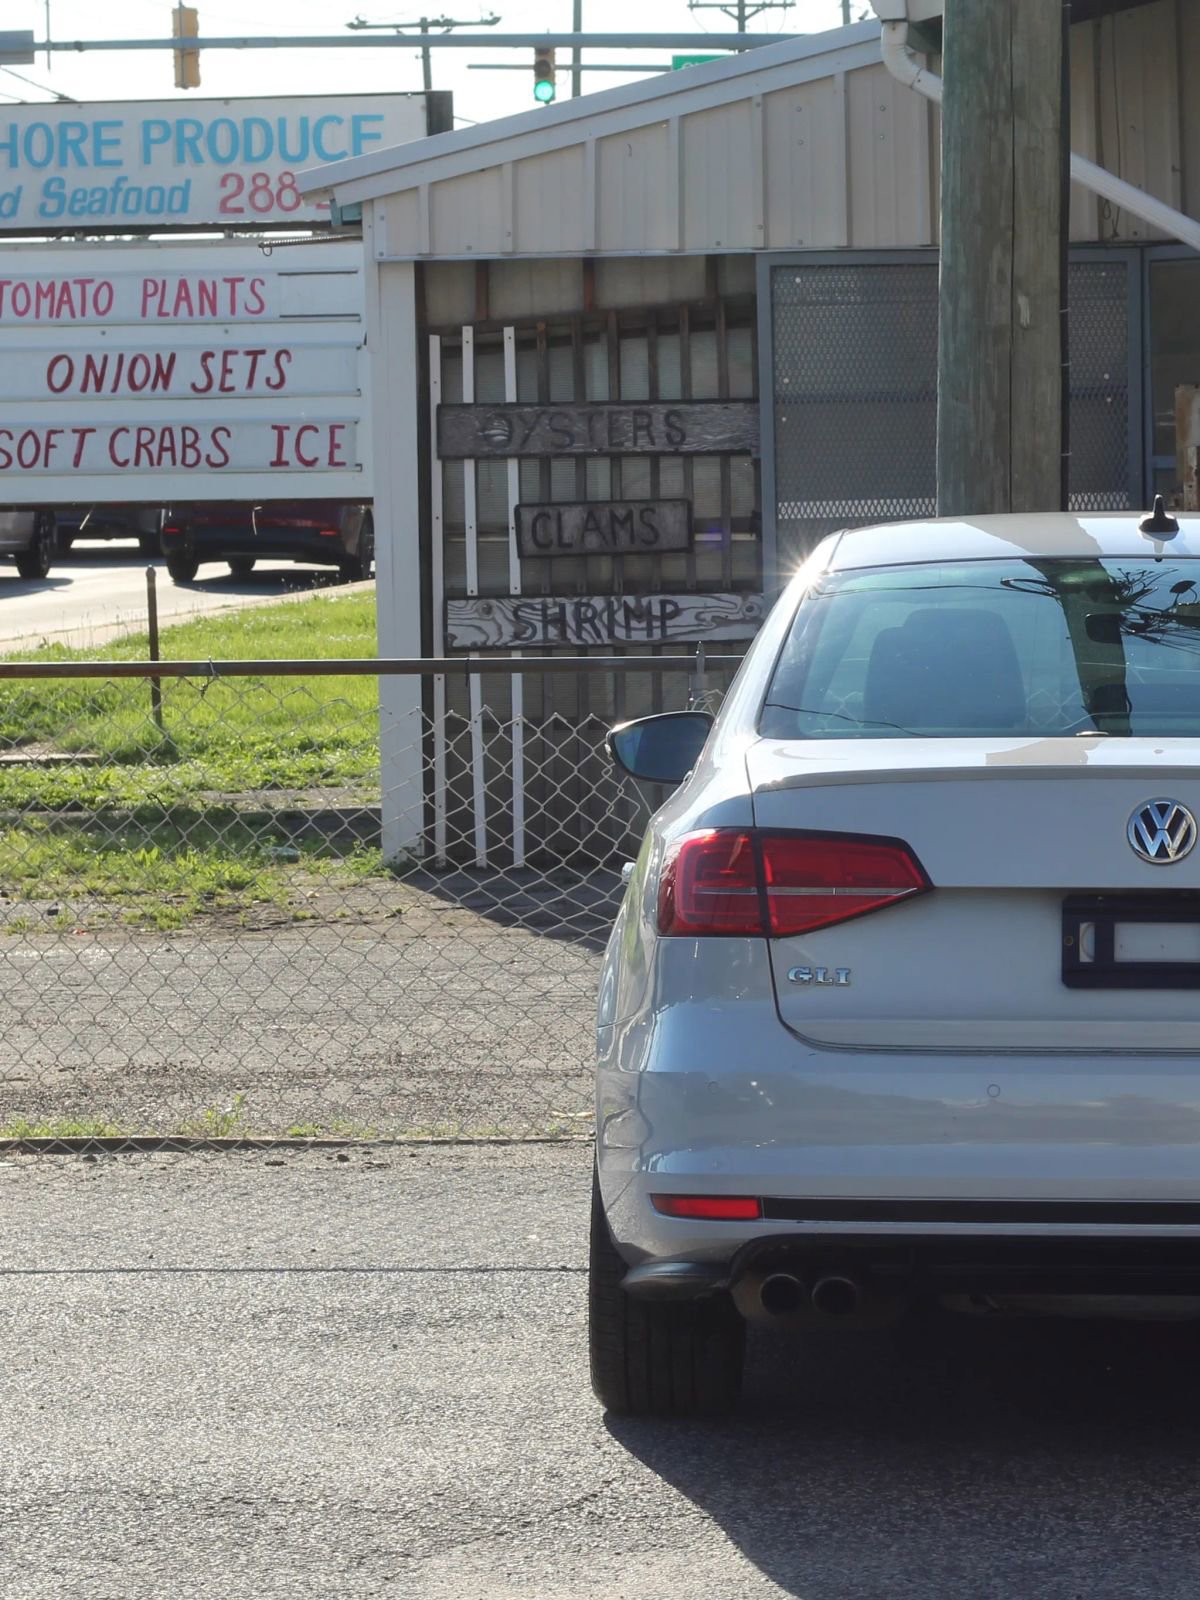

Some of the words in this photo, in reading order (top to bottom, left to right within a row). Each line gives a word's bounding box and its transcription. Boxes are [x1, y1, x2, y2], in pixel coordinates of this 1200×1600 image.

[39, 176, 191, 218] Seafood
[218, 171, 330, 214] 288
[0, 279, 114, 320] TOMATO
[141, 276, 266, 318] PLANTS
[46, 353, 177, 393] ONION
[190, 349, 292, 393] SETS
[0, 428, 97, 468] SOFT
[108, 426, 232, 467] CRABS
[269, 425, 347, 467] ICE
[479, 409, 687, 449] OYSTERS
[530, 508, 661, 549] CLAMS
[512, 599, 680, 642] SHRIMP
[787, 967, 851, 986] GLI
